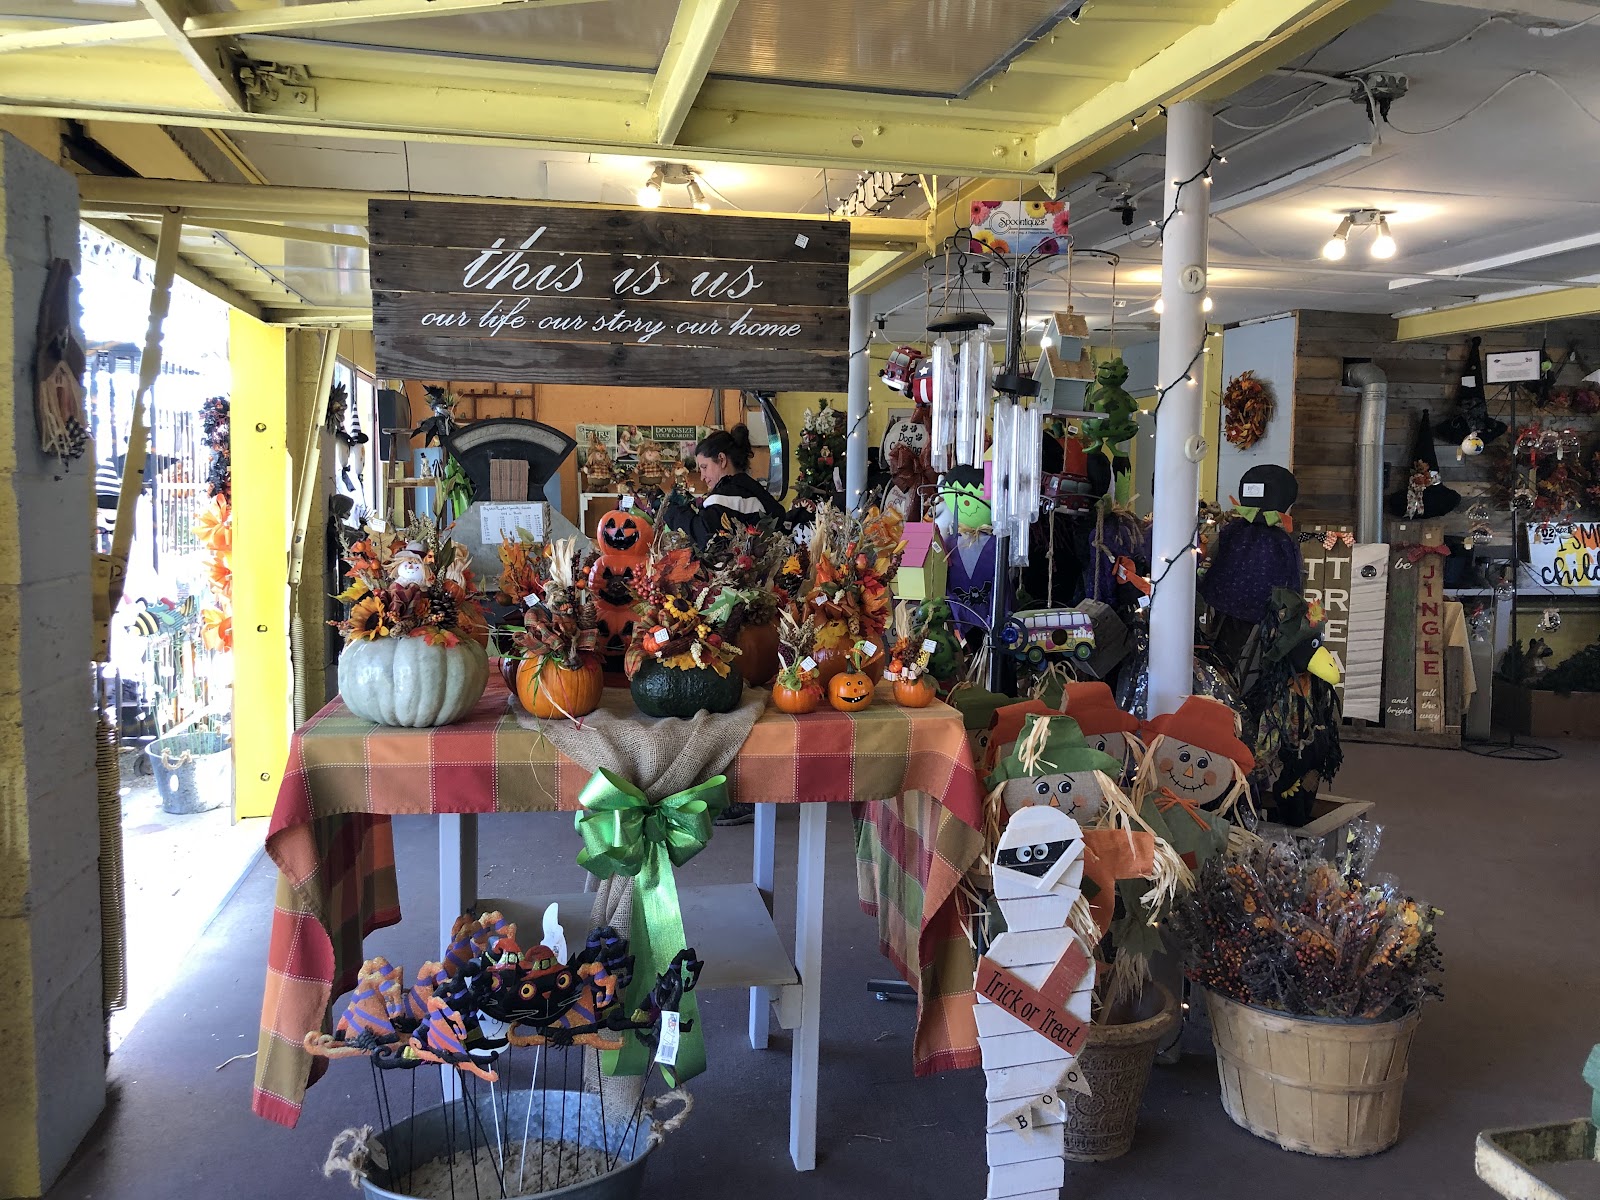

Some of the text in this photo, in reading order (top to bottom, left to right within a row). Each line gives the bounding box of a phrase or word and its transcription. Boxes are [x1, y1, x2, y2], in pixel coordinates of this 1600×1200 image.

[463, 226, 763, 300] this is us
[421, 298, 802, 344] our life our story our home
[898, 432, 914, 446] Dog
[1394, 557, 1413, 570] be
[1421, 564, 1441, 676] JINGLE
[1422, 688, 1437, 698] all
[1391, 696, 1409, 705] and
[1421, 700, 1437, 710] the
[1386, 706, 1413, 717] bright
[1418, 712, 1441, 722] way
[984, 970, 1081, 1048] Trick or Treat
